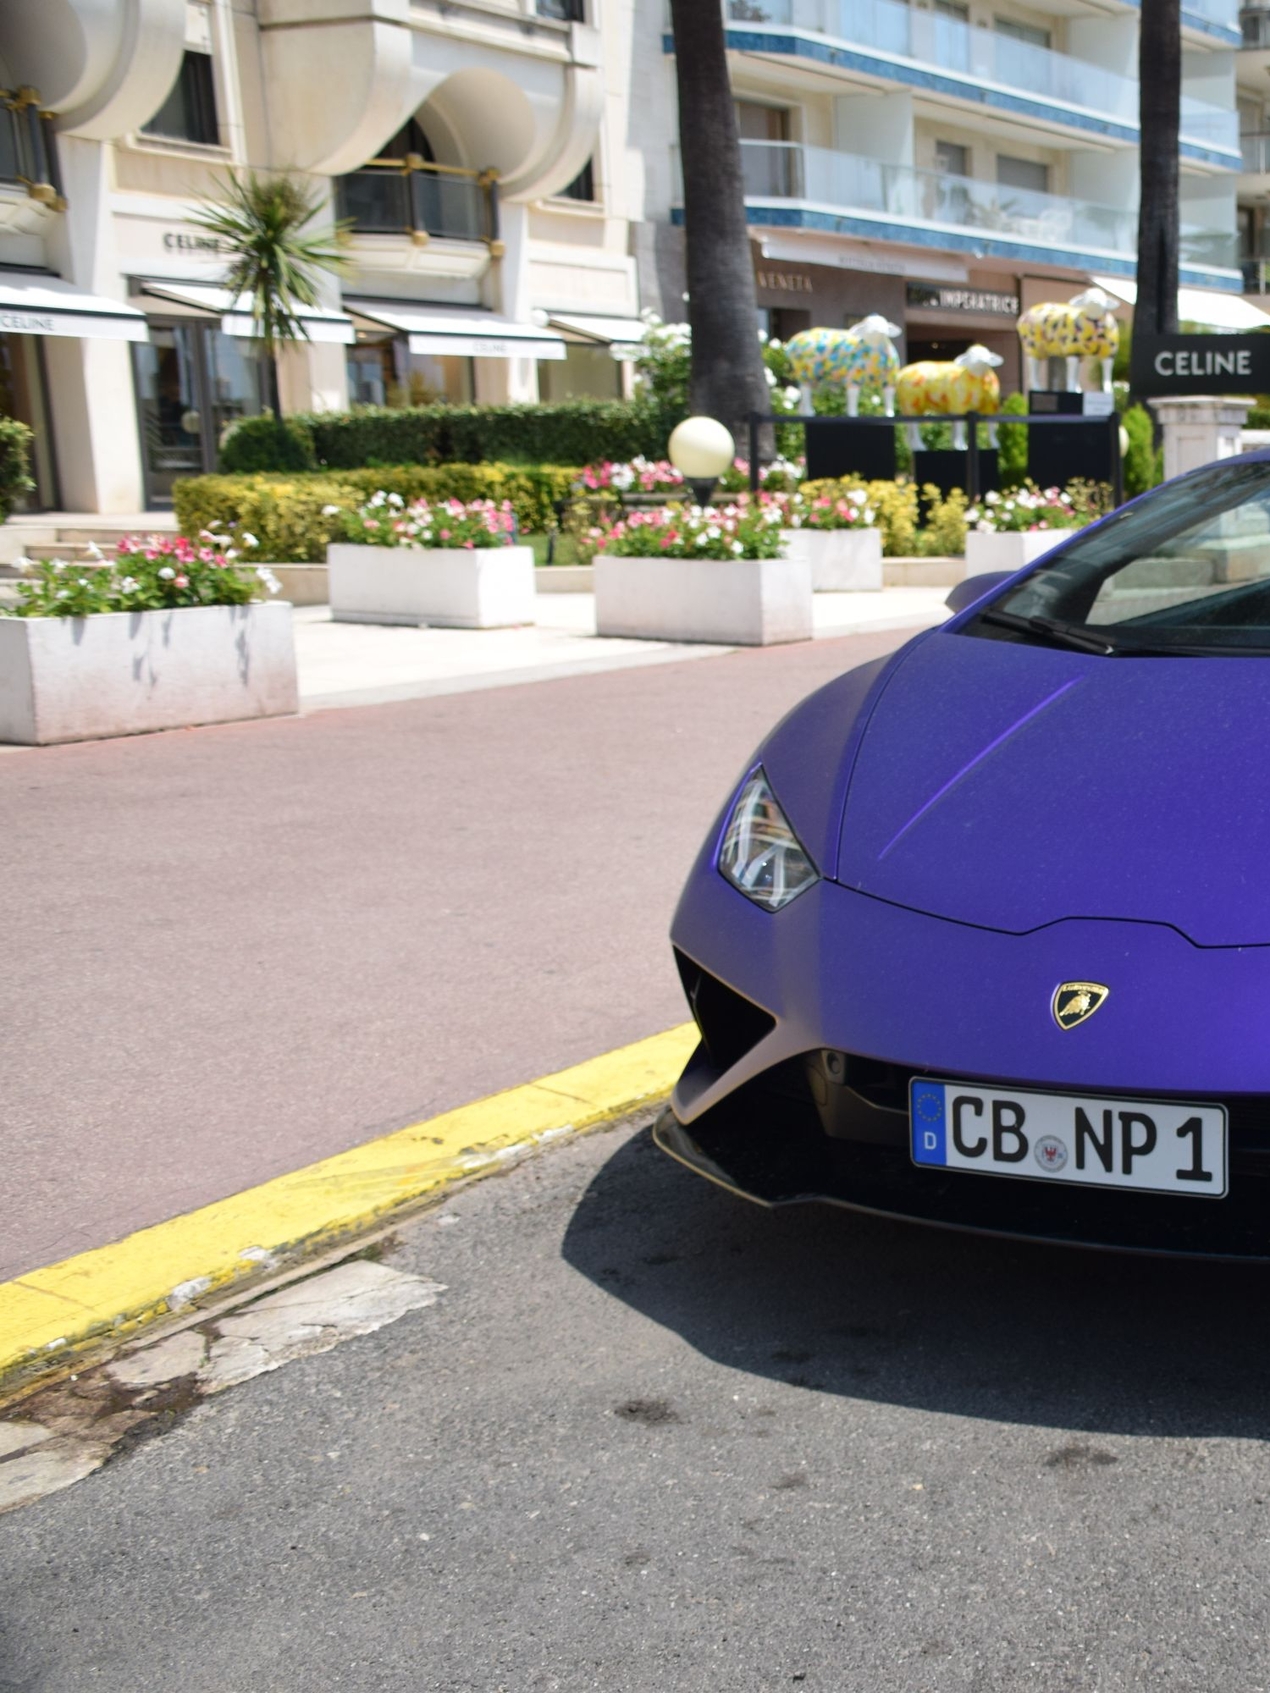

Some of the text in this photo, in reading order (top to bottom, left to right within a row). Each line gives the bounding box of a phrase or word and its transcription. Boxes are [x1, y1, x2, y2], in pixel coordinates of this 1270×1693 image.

[757, 270, 813, 293] VENETA
[1154, 350, 1252, 376] CELINE
[923, 1131, 937, 1150] D
[952, 1095, 1029, 1163] CB
